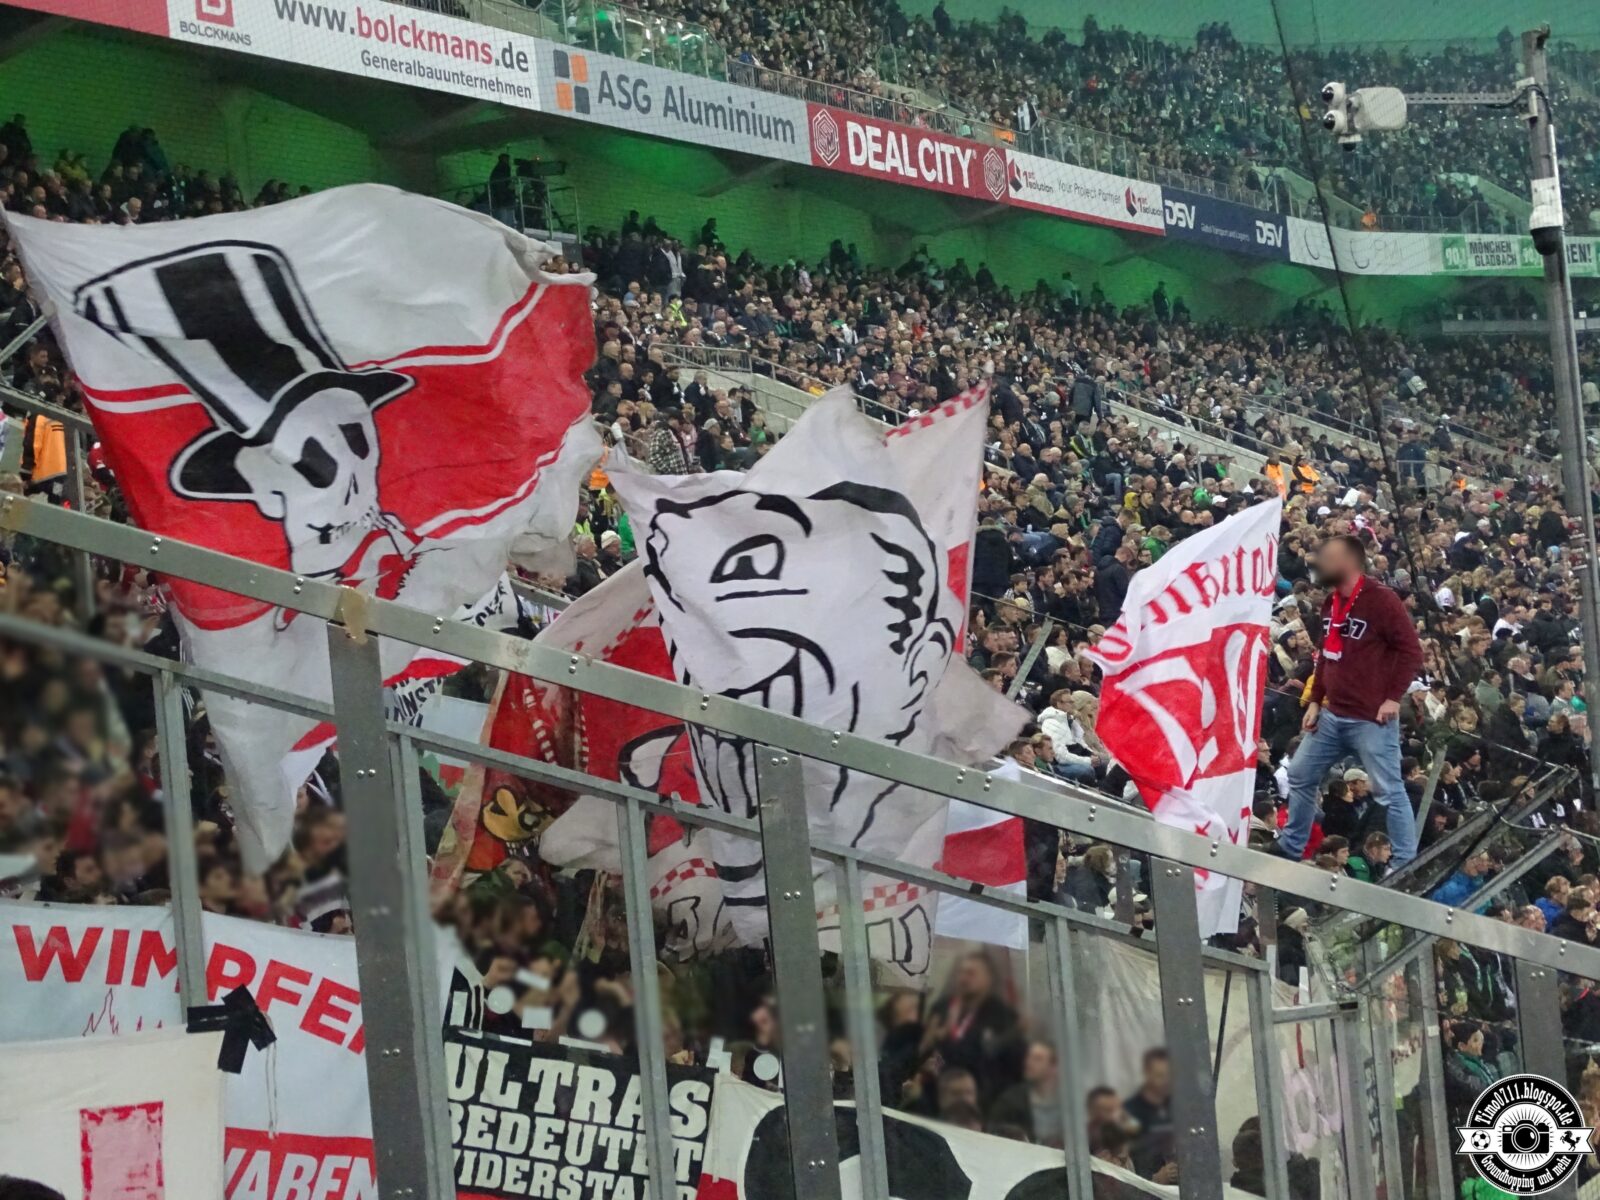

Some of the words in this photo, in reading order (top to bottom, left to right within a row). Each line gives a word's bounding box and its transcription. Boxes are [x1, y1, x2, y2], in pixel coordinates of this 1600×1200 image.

[179, 20, 252, 46] BOLCKMANS
[273, 0, 529, 73] www.bolckmans.de
[360, 49, 532, 100] Generalbauunternehmen
[598, 70, 652, 115] ASG
[662, 85, 796, 145] Aluminium
[1164, 199, 1196, 230] DSV
[1255, 219, 1283, 248] DSV
[444, 1041, 711, 1139] ULTRAS
